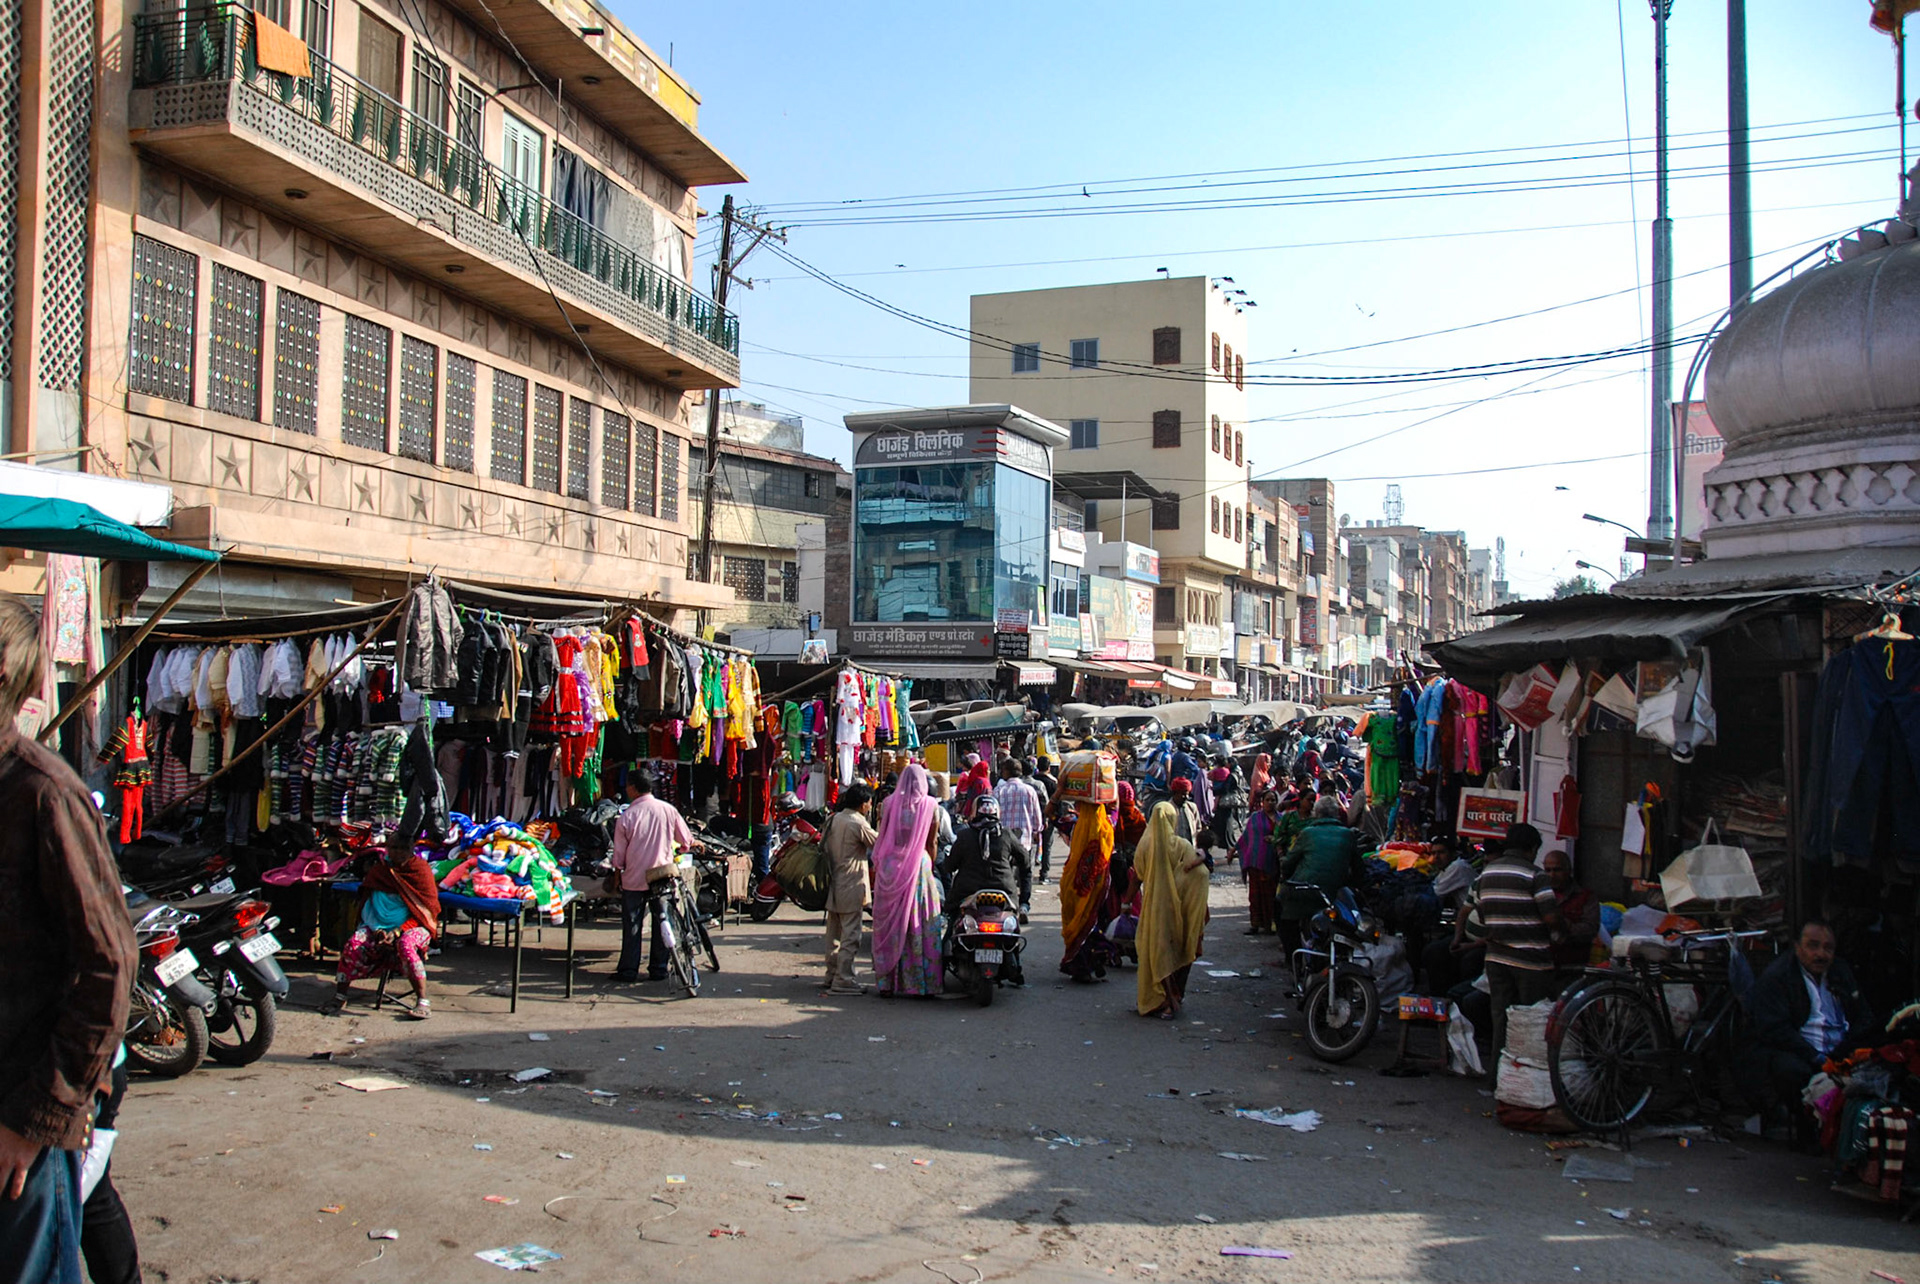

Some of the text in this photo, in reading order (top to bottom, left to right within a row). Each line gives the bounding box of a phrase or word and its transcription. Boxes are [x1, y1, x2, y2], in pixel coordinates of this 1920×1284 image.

[914, 429, 964, 451] क्लिनिक
[885, 627, 926, 643] मेडिकल
[1467, 811, 1513, 822] पान पसंद
